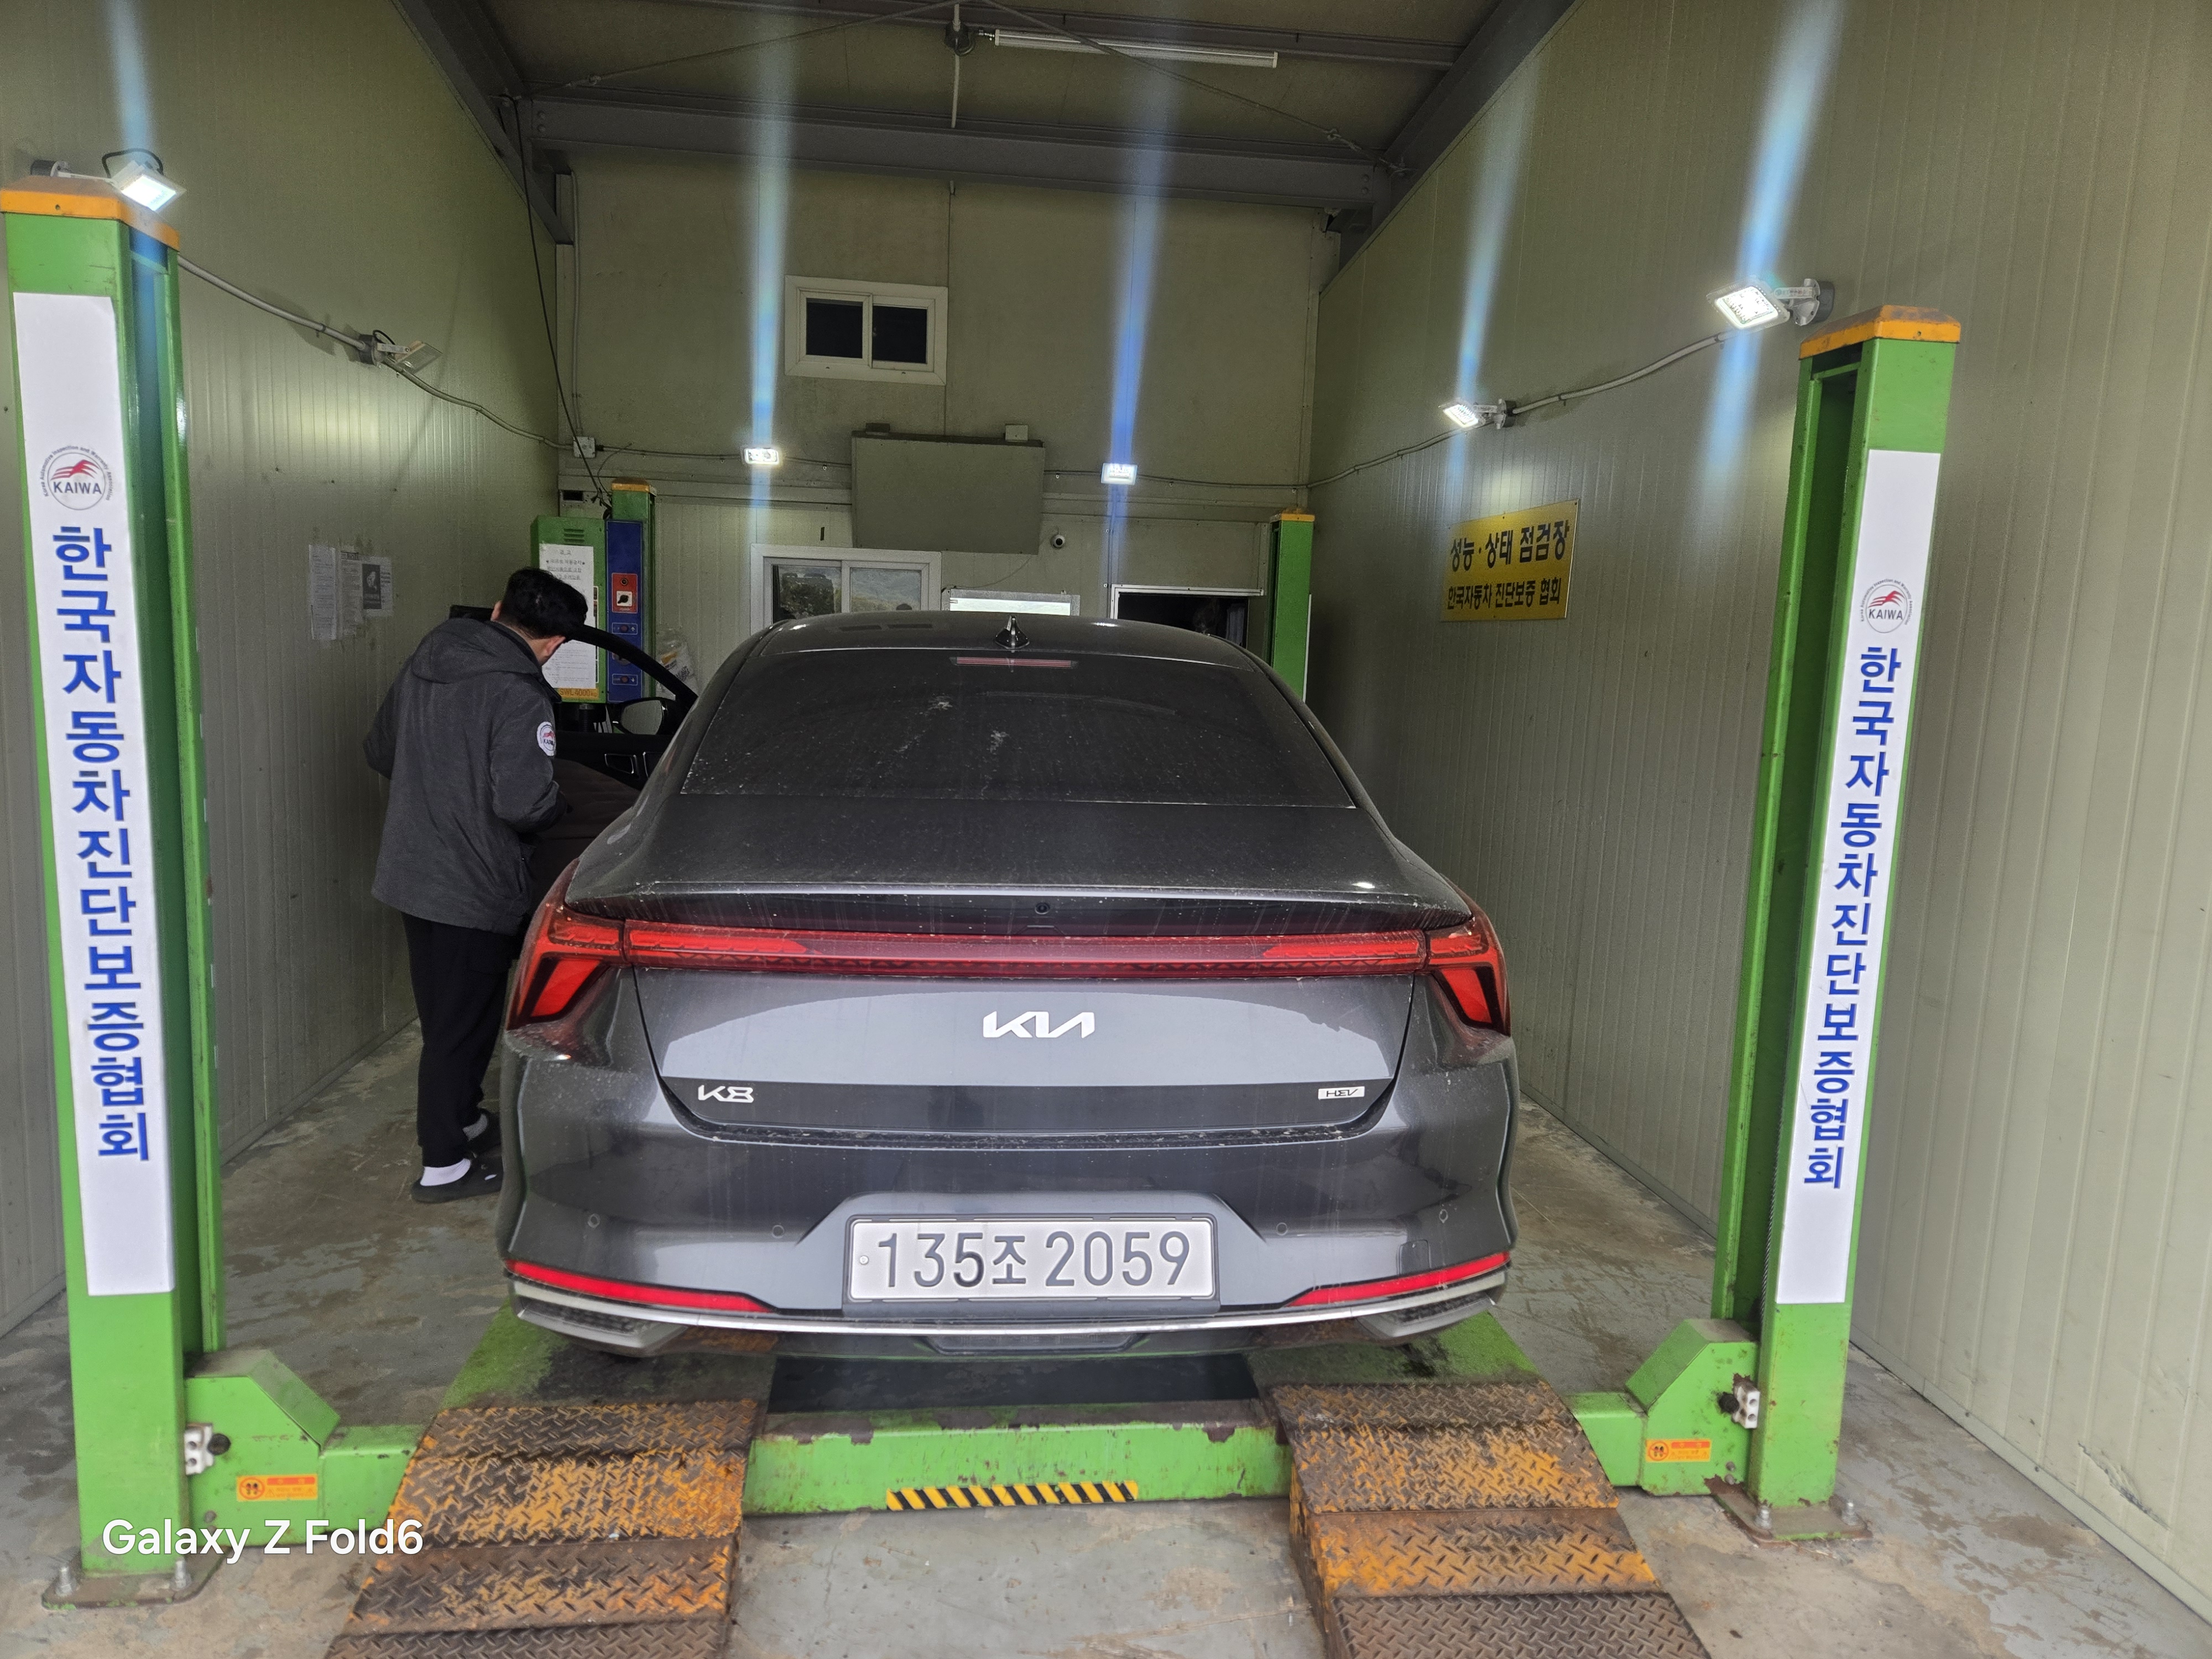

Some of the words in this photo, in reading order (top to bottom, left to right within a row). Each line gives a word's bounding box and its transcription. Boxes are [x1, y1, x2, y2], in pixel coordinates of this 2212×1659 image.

[53, 481, 102, 494] KAIWA
[1519, 520, 1570, 563] 점검장
[1495, 580, 1536, 608] 진단보증
[1539, 577, 1562, 606] 협회
[1869, 609, 1903, 620] KAIWA
[983, 1011, 1095, 1039] KIA
[698, 1084, 754, 1103] K8
[1326, 1088, 1359, 1097] HEV
[878, 1231, 1026, 1288] 135조
[1045, 1230, 1190, 1287] 2059
